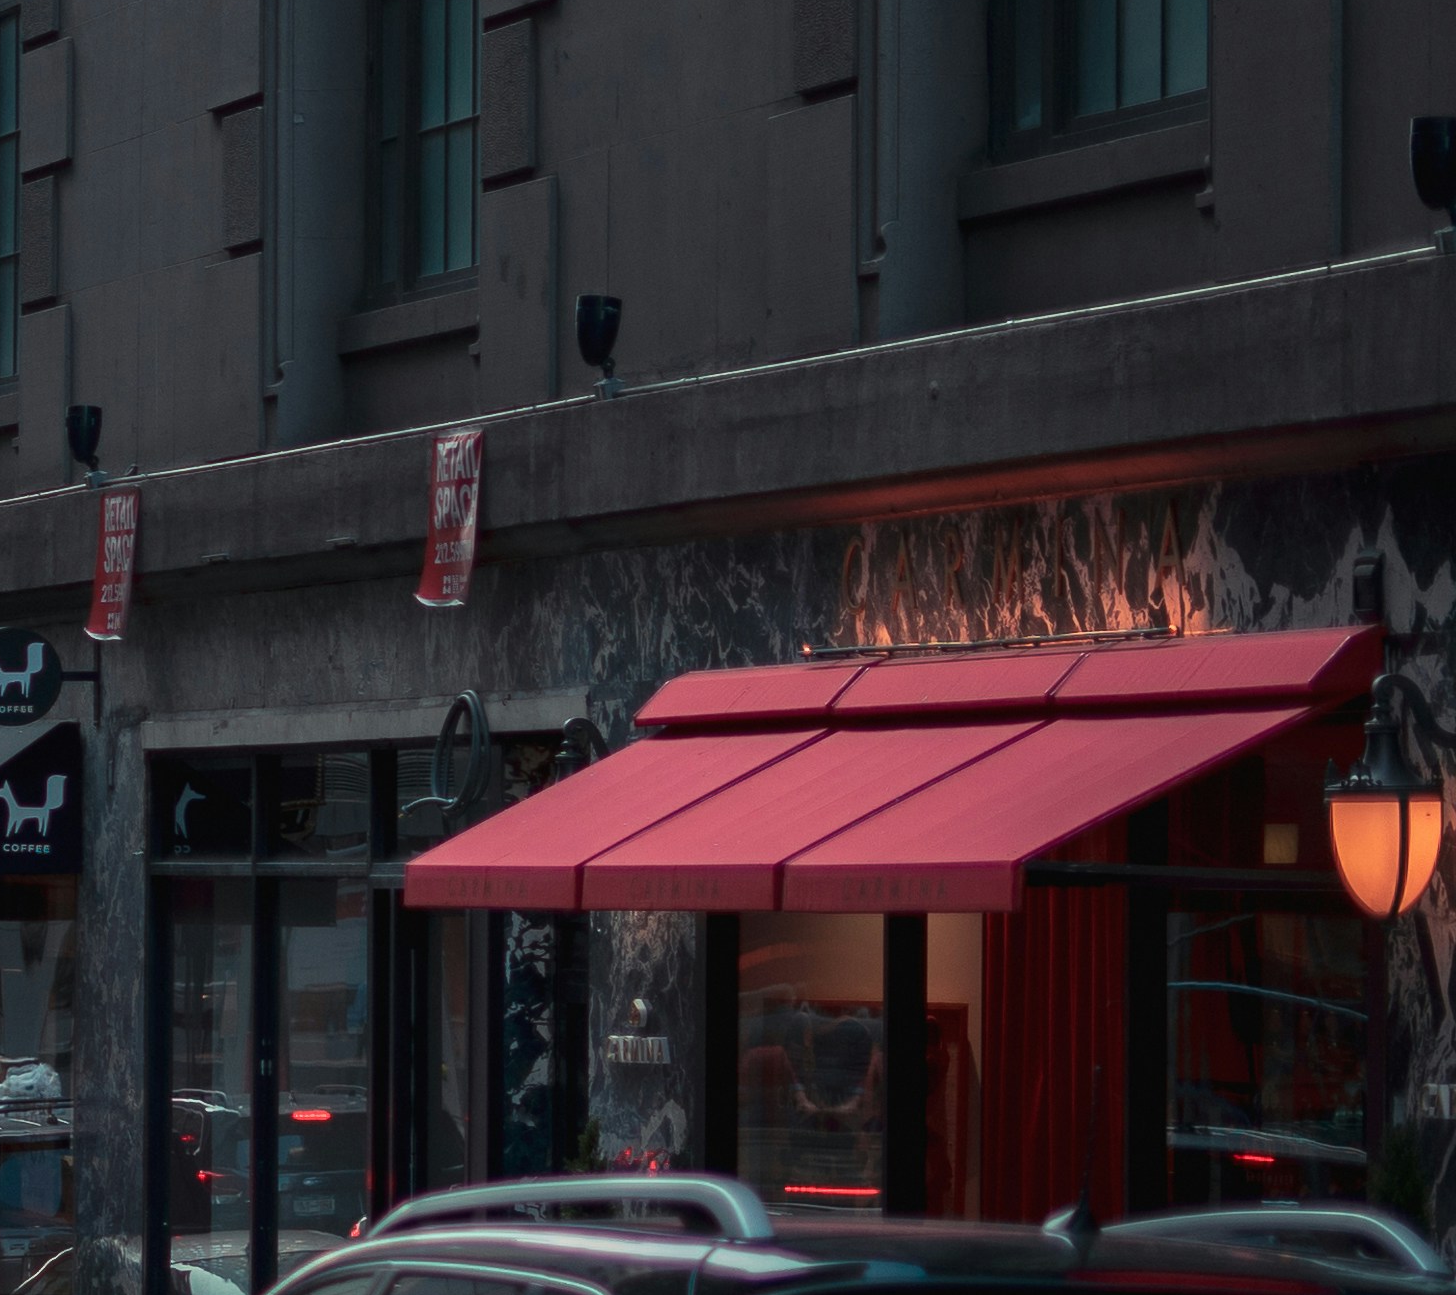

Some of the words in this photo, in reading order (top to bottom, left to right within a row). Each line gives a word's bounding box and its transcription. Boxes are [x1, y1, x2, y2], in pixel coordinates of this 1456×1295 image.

[436, 438, 479, 483] RETAIL
[841, 497, 1185, 614] CARMINA
[2, 843, 51, 854] COFFEE
